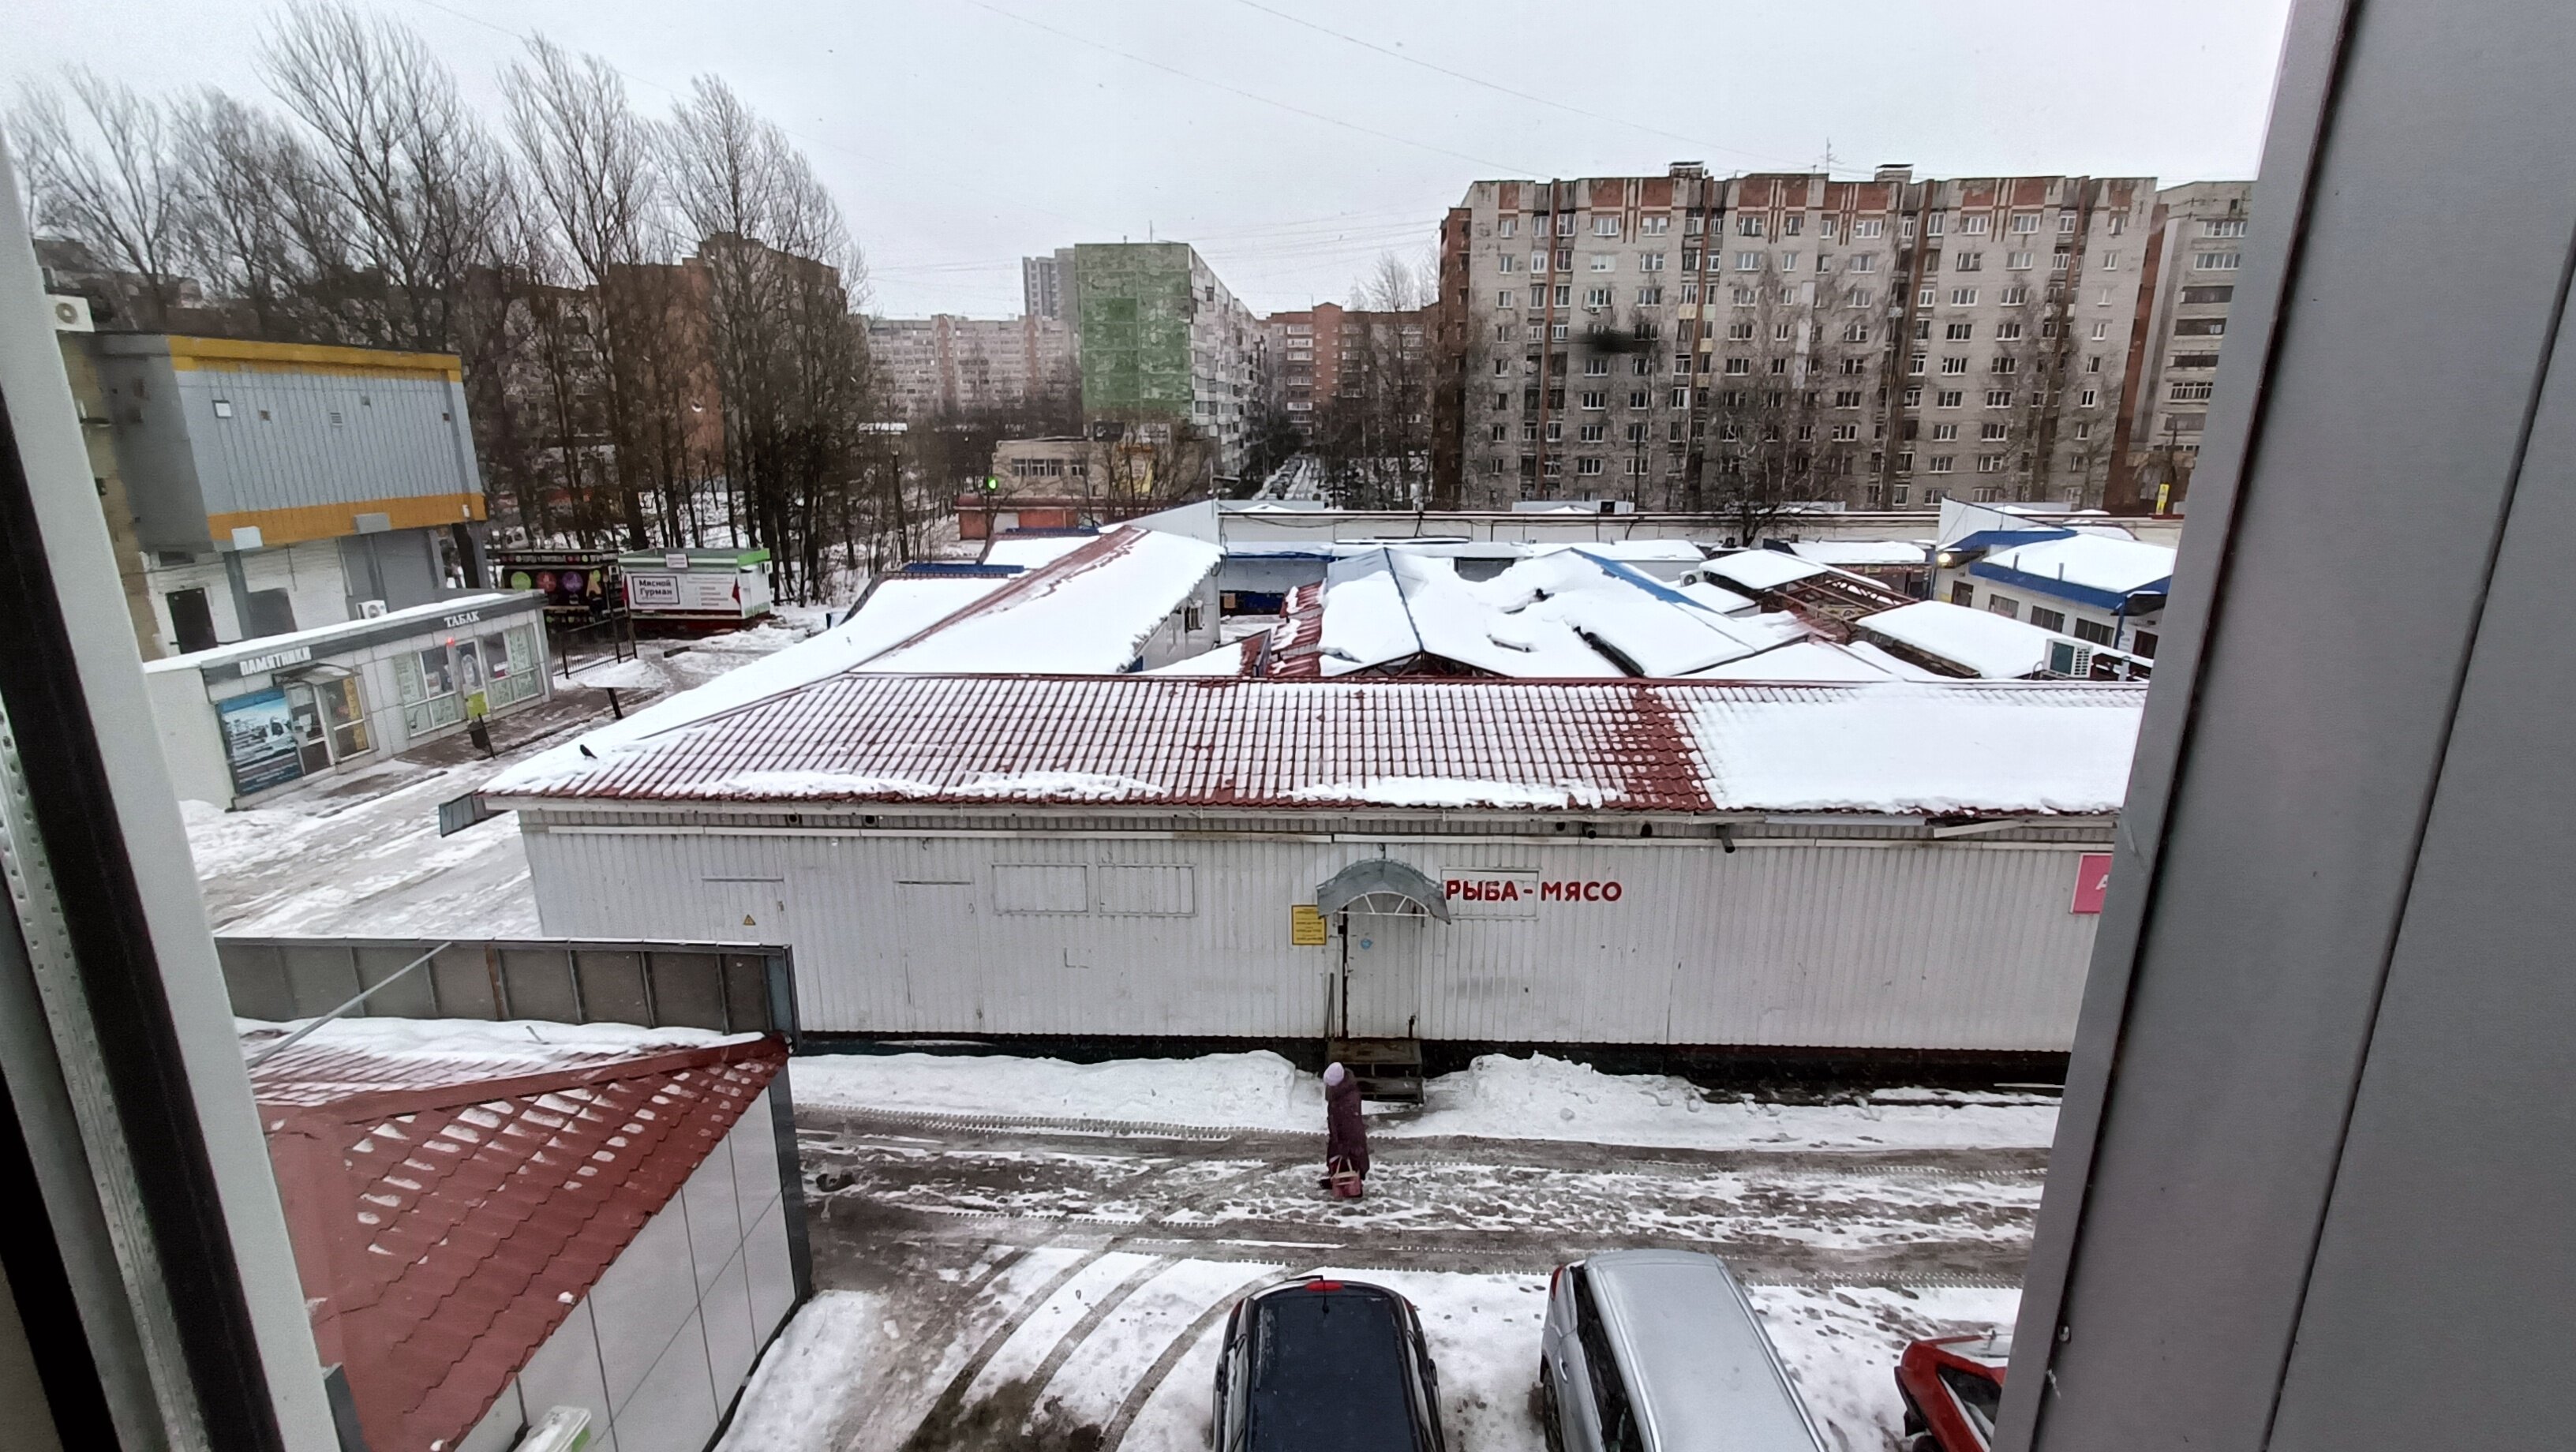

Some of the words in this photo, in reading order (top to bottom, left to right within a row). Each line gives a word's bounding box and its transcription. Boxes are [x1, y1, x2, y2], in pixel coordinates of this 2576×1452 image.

[640, 587, 672, 597] Гурман
[444, 611, 480, 627] ТАБАК
[239, 646, 312, 676] ПАМЯТНИКИ
[1446, 880, 1518, 901] РЫБА
[1541, 881, 1622, 901] МЯСО
